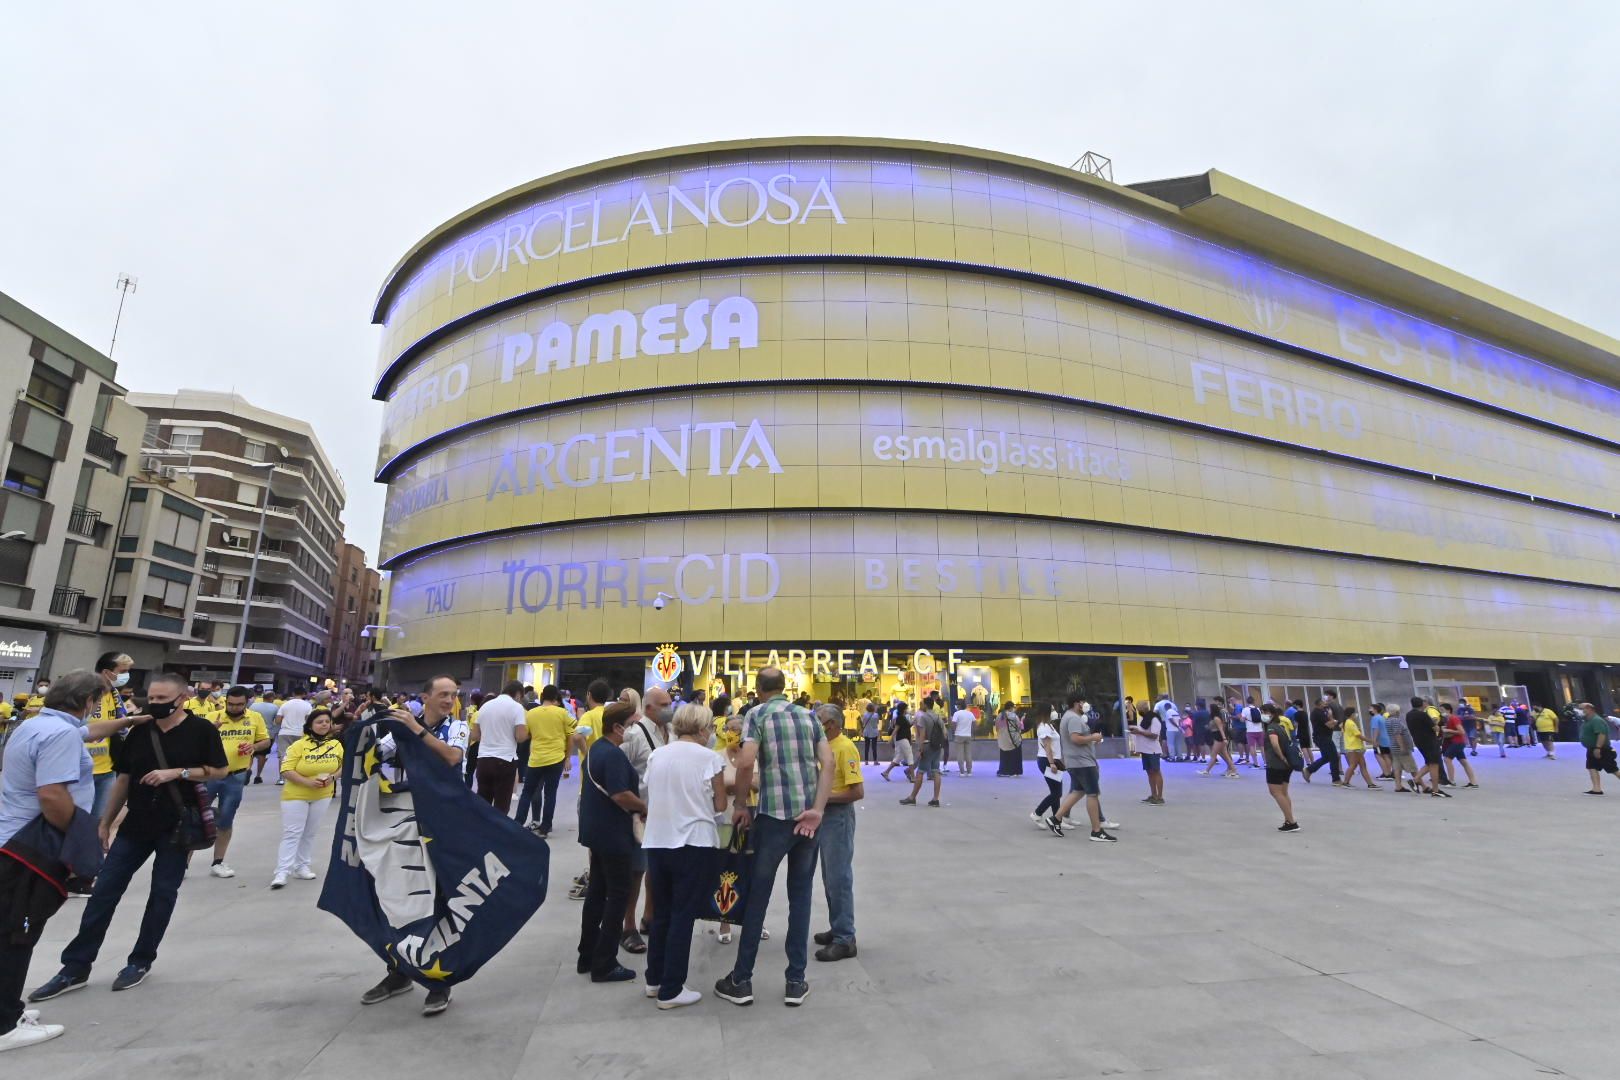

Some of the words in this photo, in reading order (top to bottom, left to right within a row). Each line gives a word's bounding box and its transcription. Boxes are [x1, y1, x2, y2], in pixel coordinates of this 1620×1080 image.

[448, 173, 847, 295] PORCELANOSA
[500, 296, 759, 383] PAMESA
[1190, 360, 1362, 442] FERRO
[486, 418, 784, 501] ARGENTA
[425, 582, 457, 615] TAU
[503, 552, 782, 615] TORRECID
[864, 558, 1065, 596] BESTILE
[690, 648, 899, 676] VILLARREAL
[220, 729, 252, 737] AMESA
